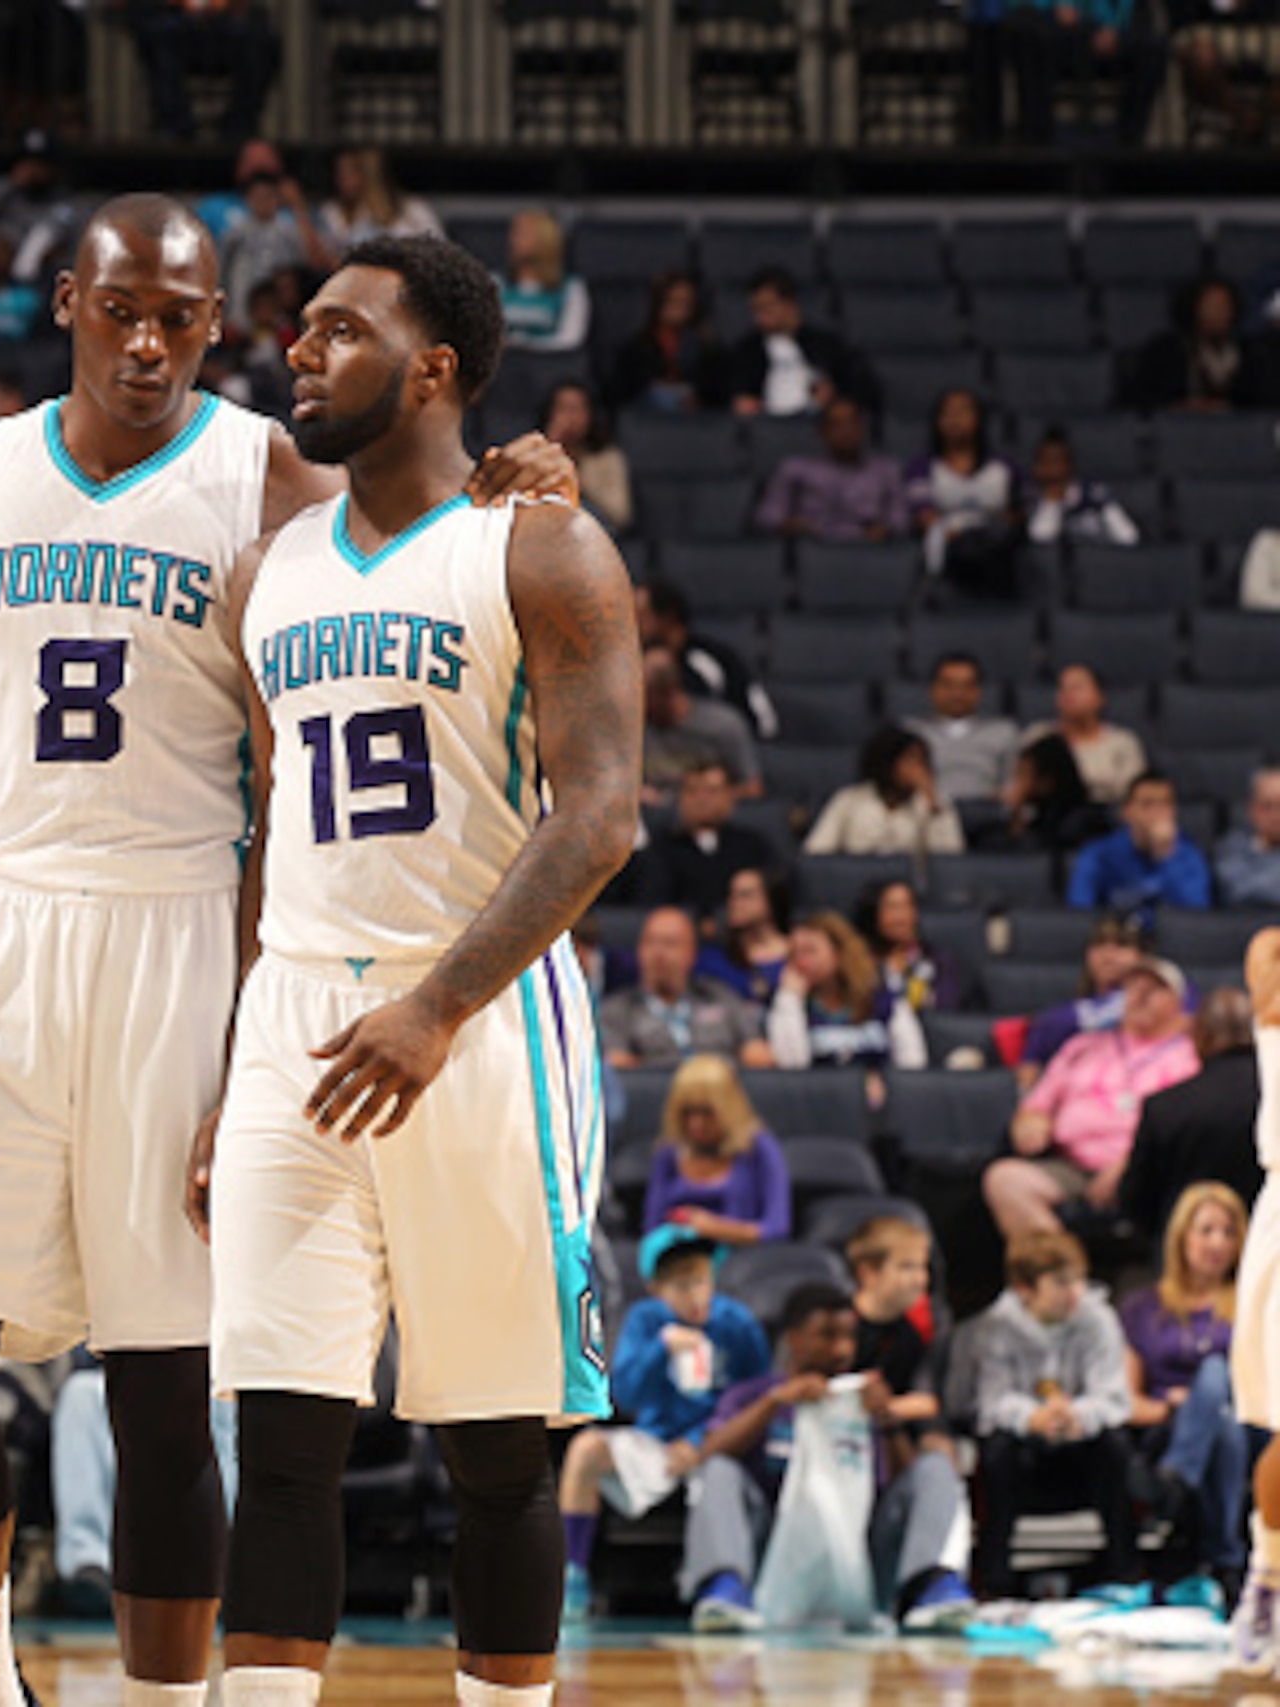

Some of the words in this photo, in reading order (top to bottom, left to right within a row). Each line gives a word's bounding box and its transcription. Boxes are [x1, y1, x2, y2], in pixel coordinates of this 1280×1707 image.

[35, 639, 129, 762] 8
[261, 612, 468, 700] HORNETS
[298, 704, 437, 845] 19
